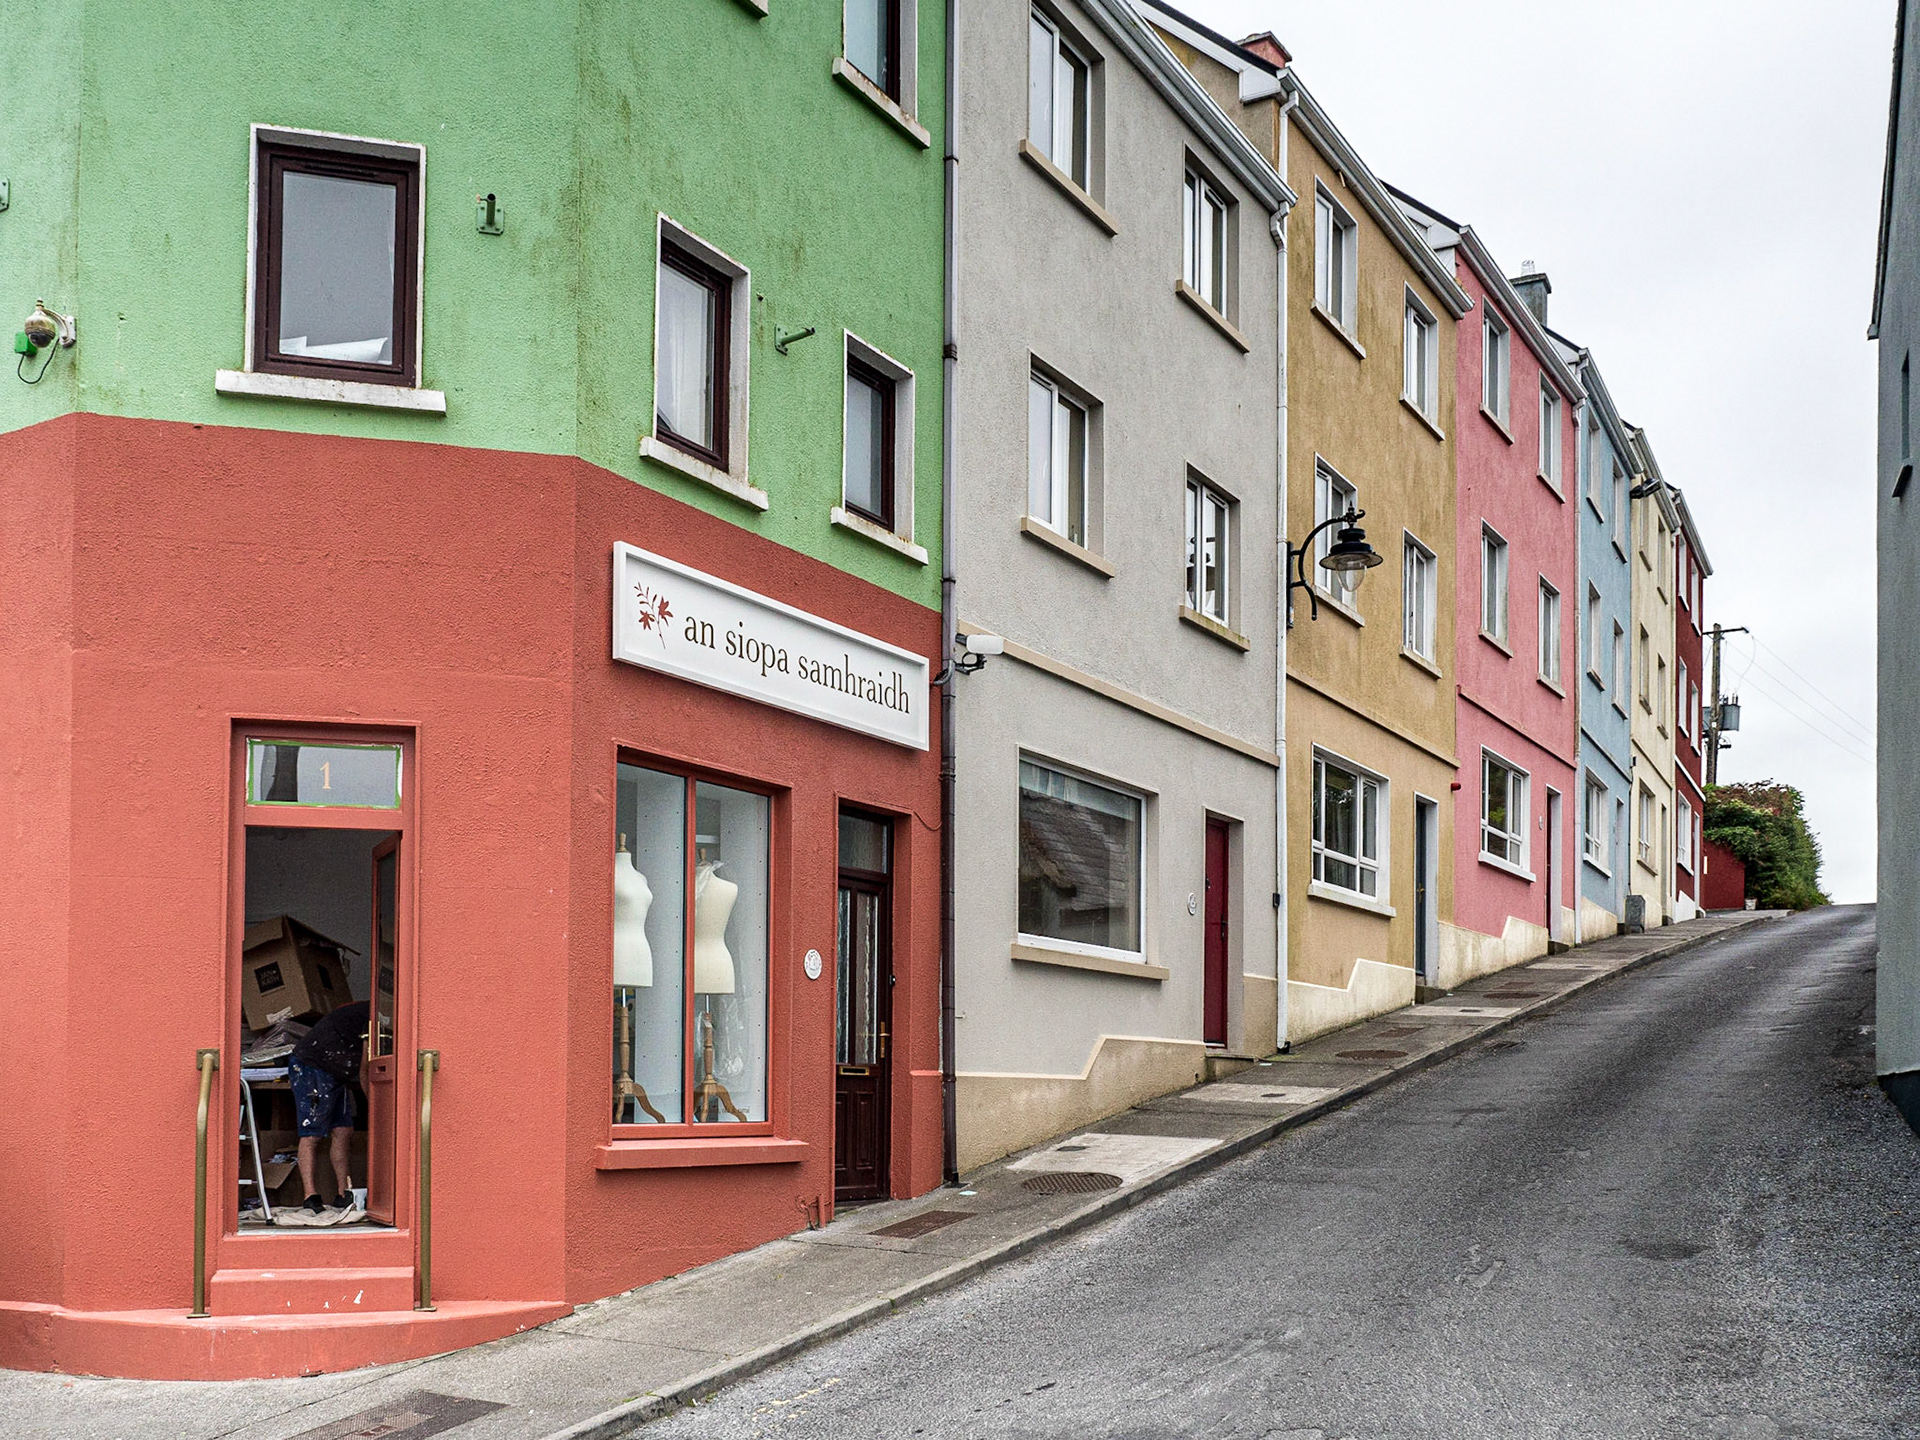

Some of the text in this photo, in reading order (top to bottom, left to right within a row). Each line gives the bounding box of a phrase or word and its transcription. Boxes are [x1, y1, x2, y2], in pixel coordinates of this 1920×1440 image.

[684, 616, 910, 714] an siopa samhraidh
[319, 761, 332, 790] 1
